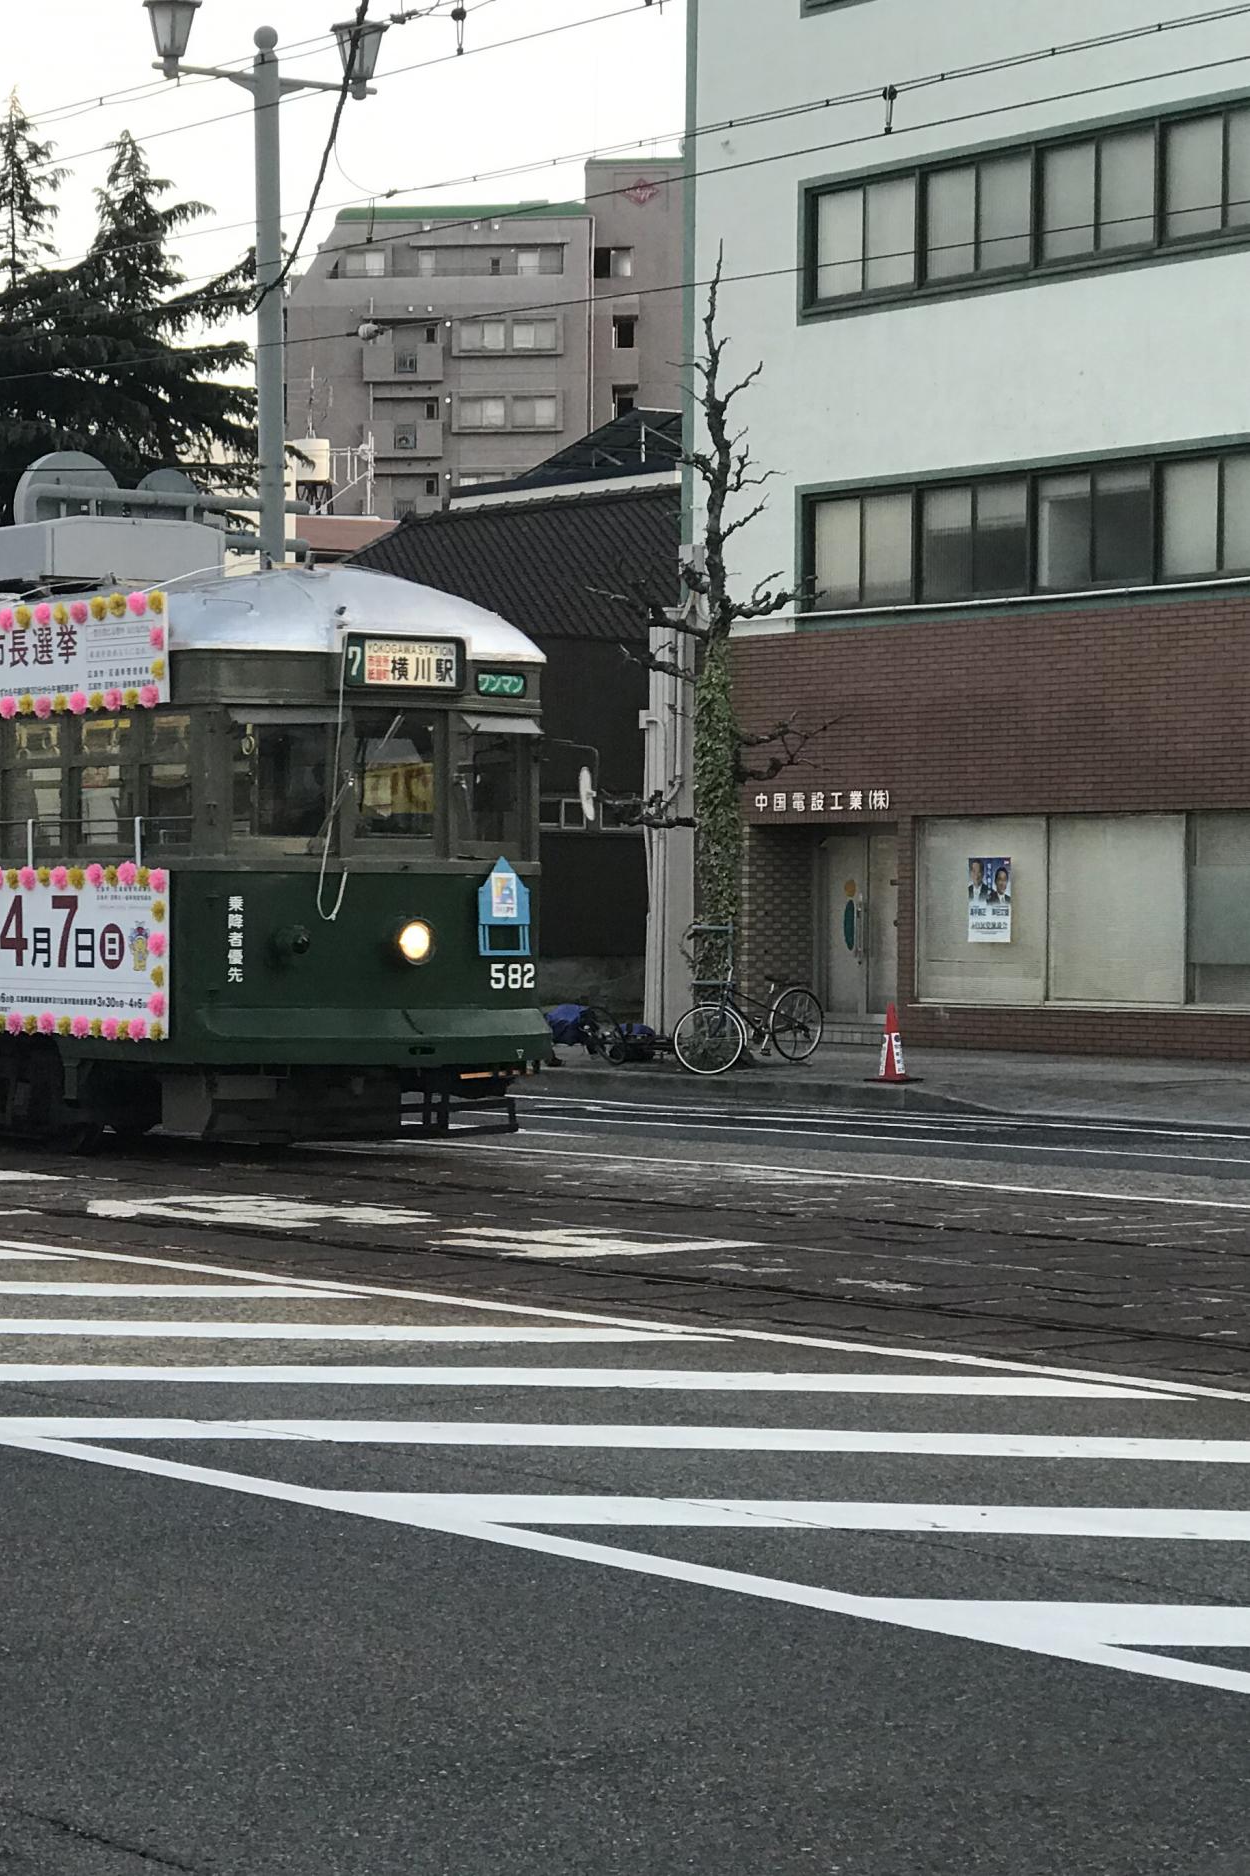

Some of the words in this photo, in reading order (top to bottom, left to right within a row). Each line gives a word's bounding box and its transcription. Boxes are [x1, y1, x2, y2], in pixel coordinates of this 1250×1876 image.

[390, 655, 455, 683] 横川駅
[477, 674, 525, 694] ワンマン
[227, 895, 244, 983] 乗降者優先
[490, 963, 536, 989] 582
